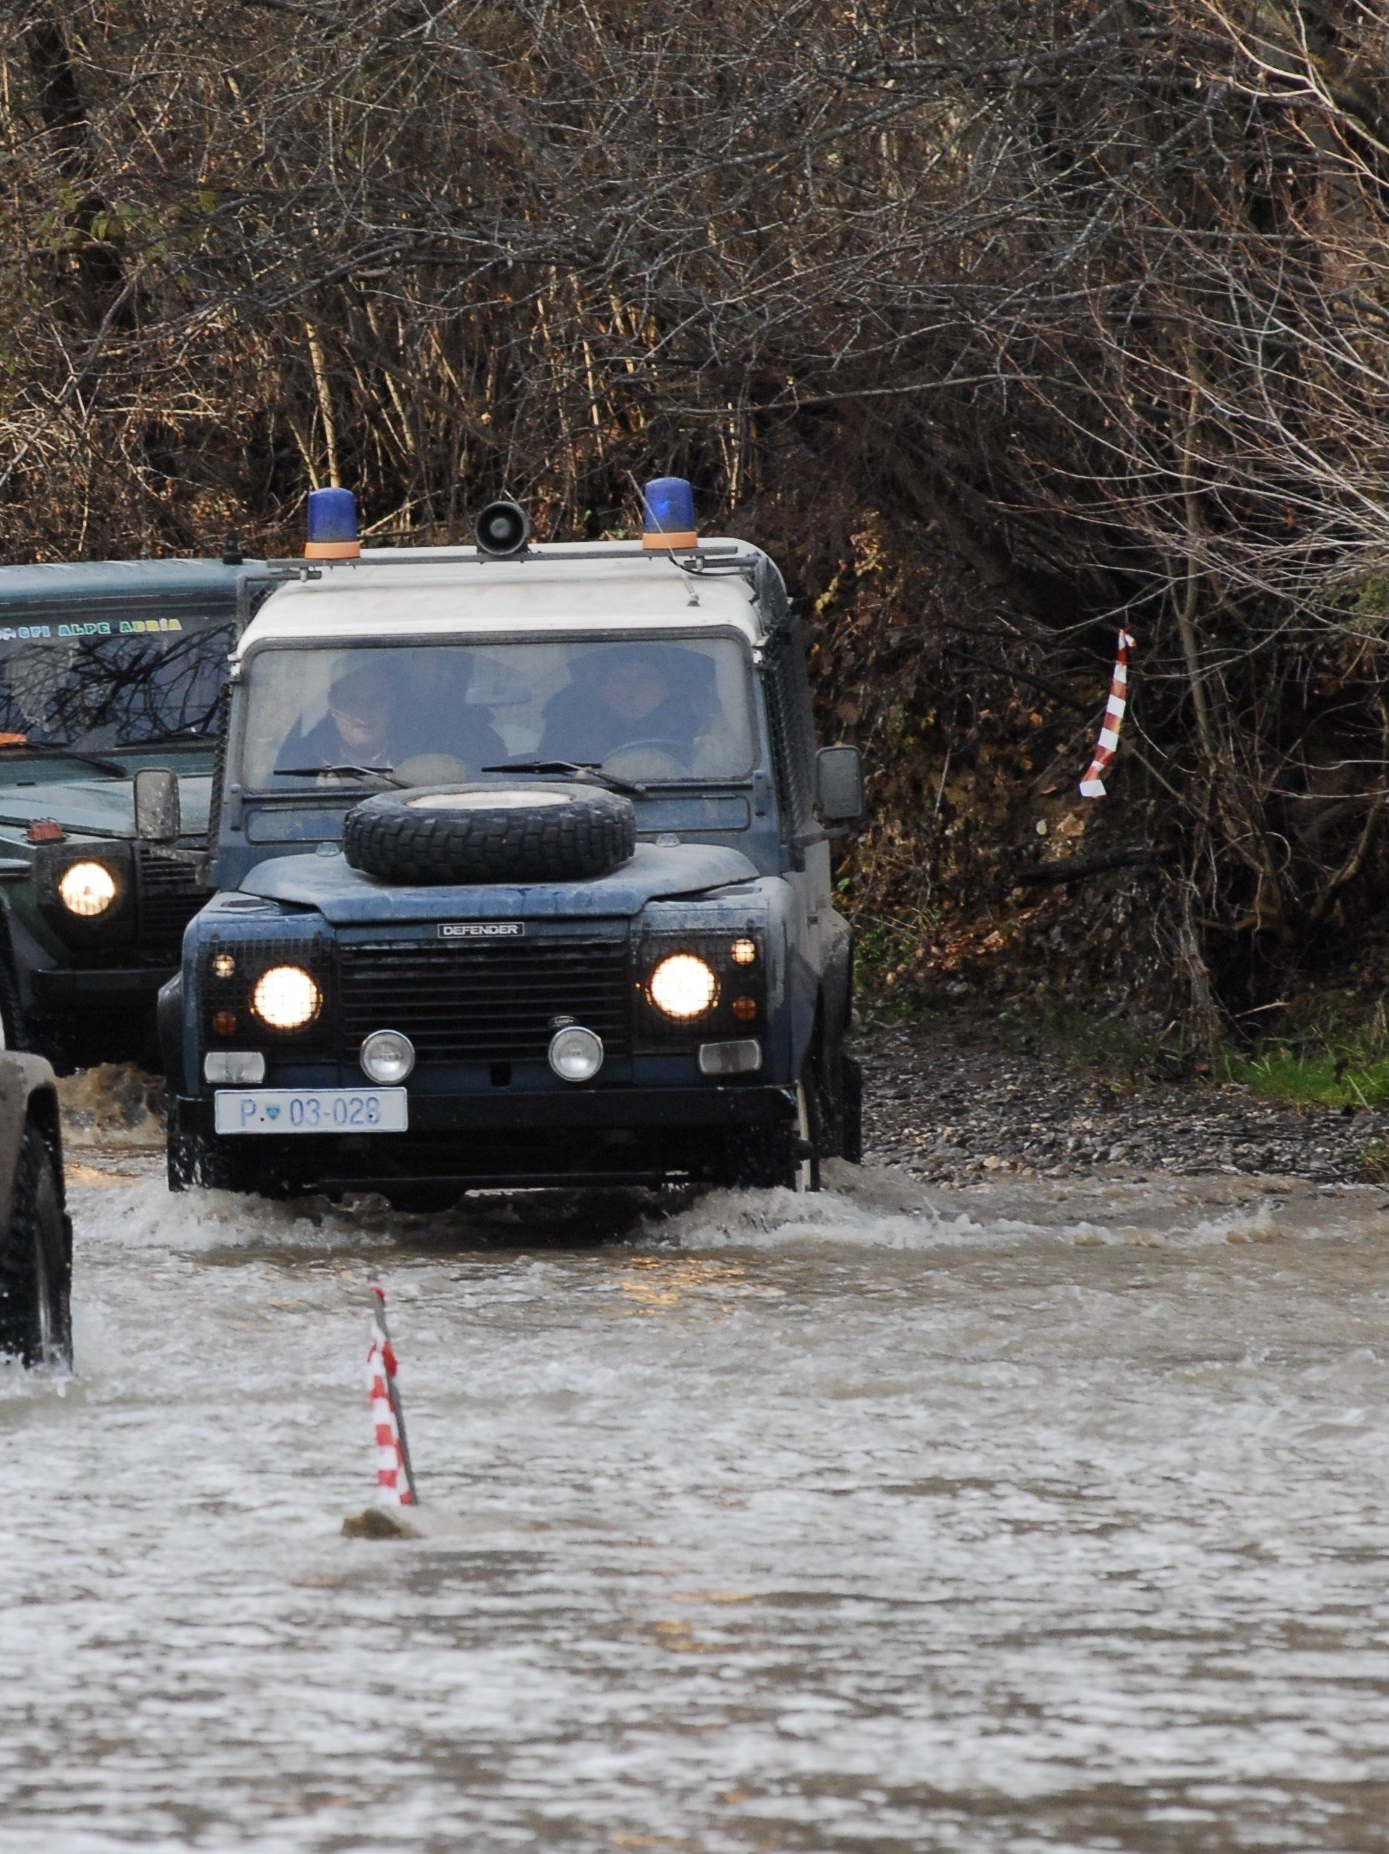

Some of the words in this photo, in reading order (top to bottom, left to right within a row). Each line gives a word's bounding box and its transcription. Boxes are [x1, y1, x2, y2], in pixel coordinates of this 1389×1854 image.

[58, 622, 112, 637] ALPE
[443, 925, 519, 936] DEFENDER
[240, 1099, 257, 1126] P
[289, 1096, 380, 1126] 03-028
